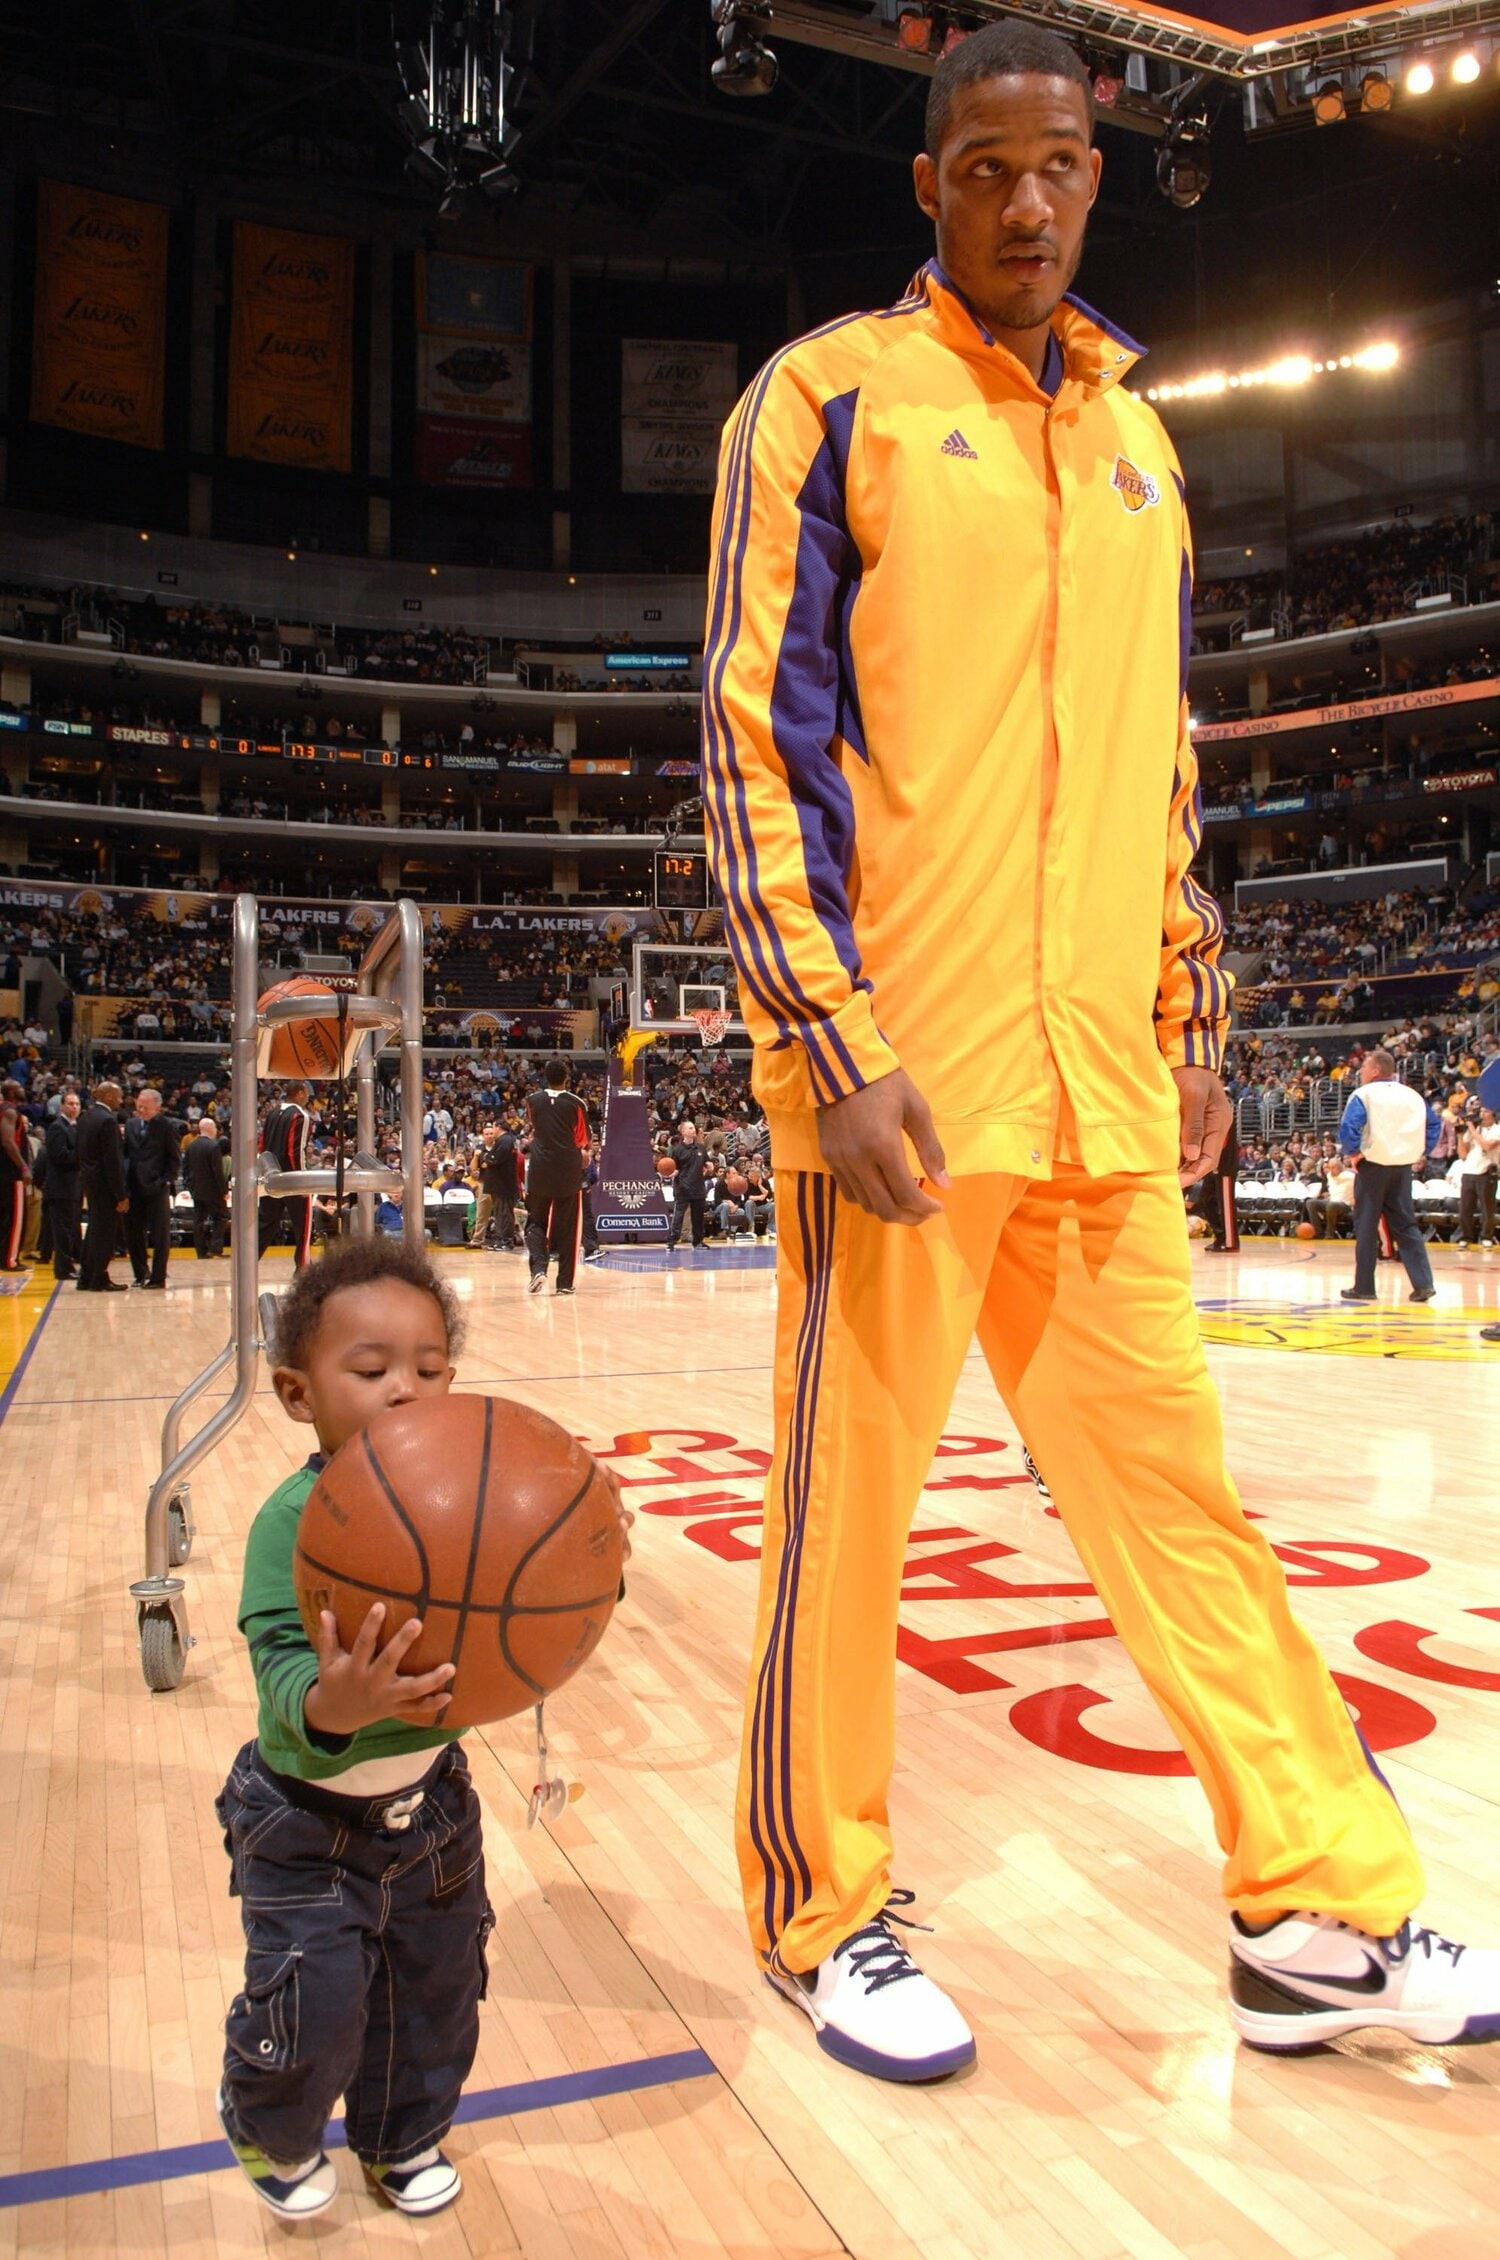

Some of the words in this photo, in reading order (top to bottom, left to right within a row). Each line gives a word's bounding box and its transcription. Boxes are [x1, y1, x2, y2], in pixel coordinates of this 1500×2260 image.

[654, 364, 703, 381] KINGS
[648, 399, 710, 410] CHAMPIONS
[654, 443, 703, 459] KINGS
[940, 444, 978, 460] adidas
[648, 477, 710, 489] CHAMPIONS
[1112, 457, 1160, 504] LAKERS
[608, 656, 651, 665] American
[652, 655, 688, 666] Express
[1317, 708, 1344, 723] THE
[1348, 700, 1401, 717] BICYCLE
[1403, 691, 1453, 708] CASINO
[112, 726, 170, 745] STAPLES
[1233, 720, 1279, 736] CASINO
[238, 740, 248, 754] 0
[382, 751, 391, 765] 0
[1445, 772, 1494, 788] TOYOTA
[1266, 798, 1305, 812] PEPSI
[260, 907, 340, 924] LAKERS
[473, 916, 511, 930] L.A.
[518, 917, 593, 931] LAKERS
[602, 1181, 662, 1191] PECHANGA
[642, 1218, 663, 1226] Bank
